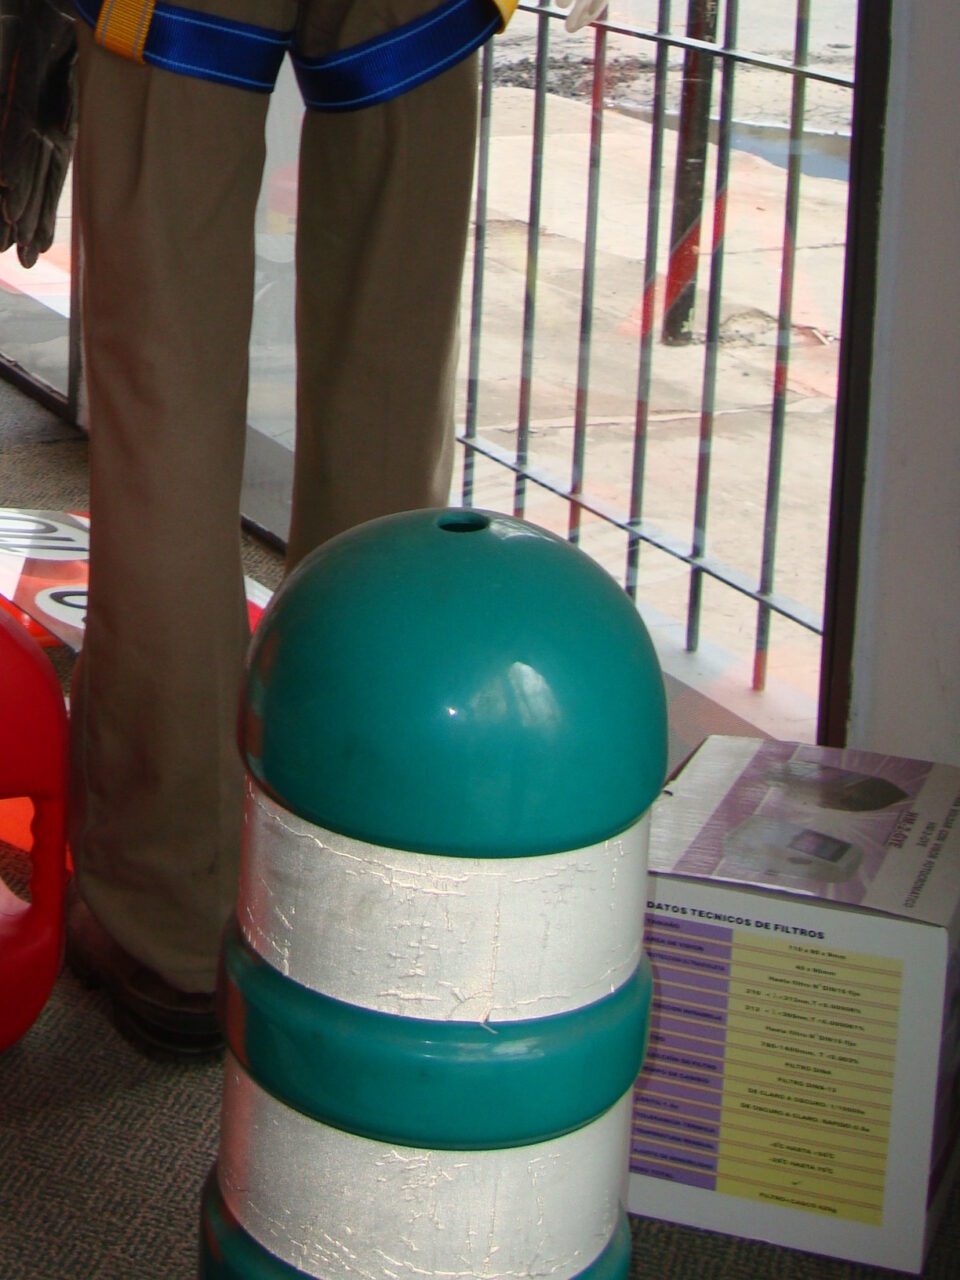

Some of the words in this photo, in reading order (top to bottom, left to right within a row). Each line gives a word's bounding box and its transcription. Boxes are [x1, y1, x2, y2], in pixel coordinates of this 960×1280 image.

[646, 900, 688, 915] DATOS
[691, 908, 752, 927] TECNICOS
[754, 920, 772, 930] DE
[773, 923, 825, 940] FILTROS
